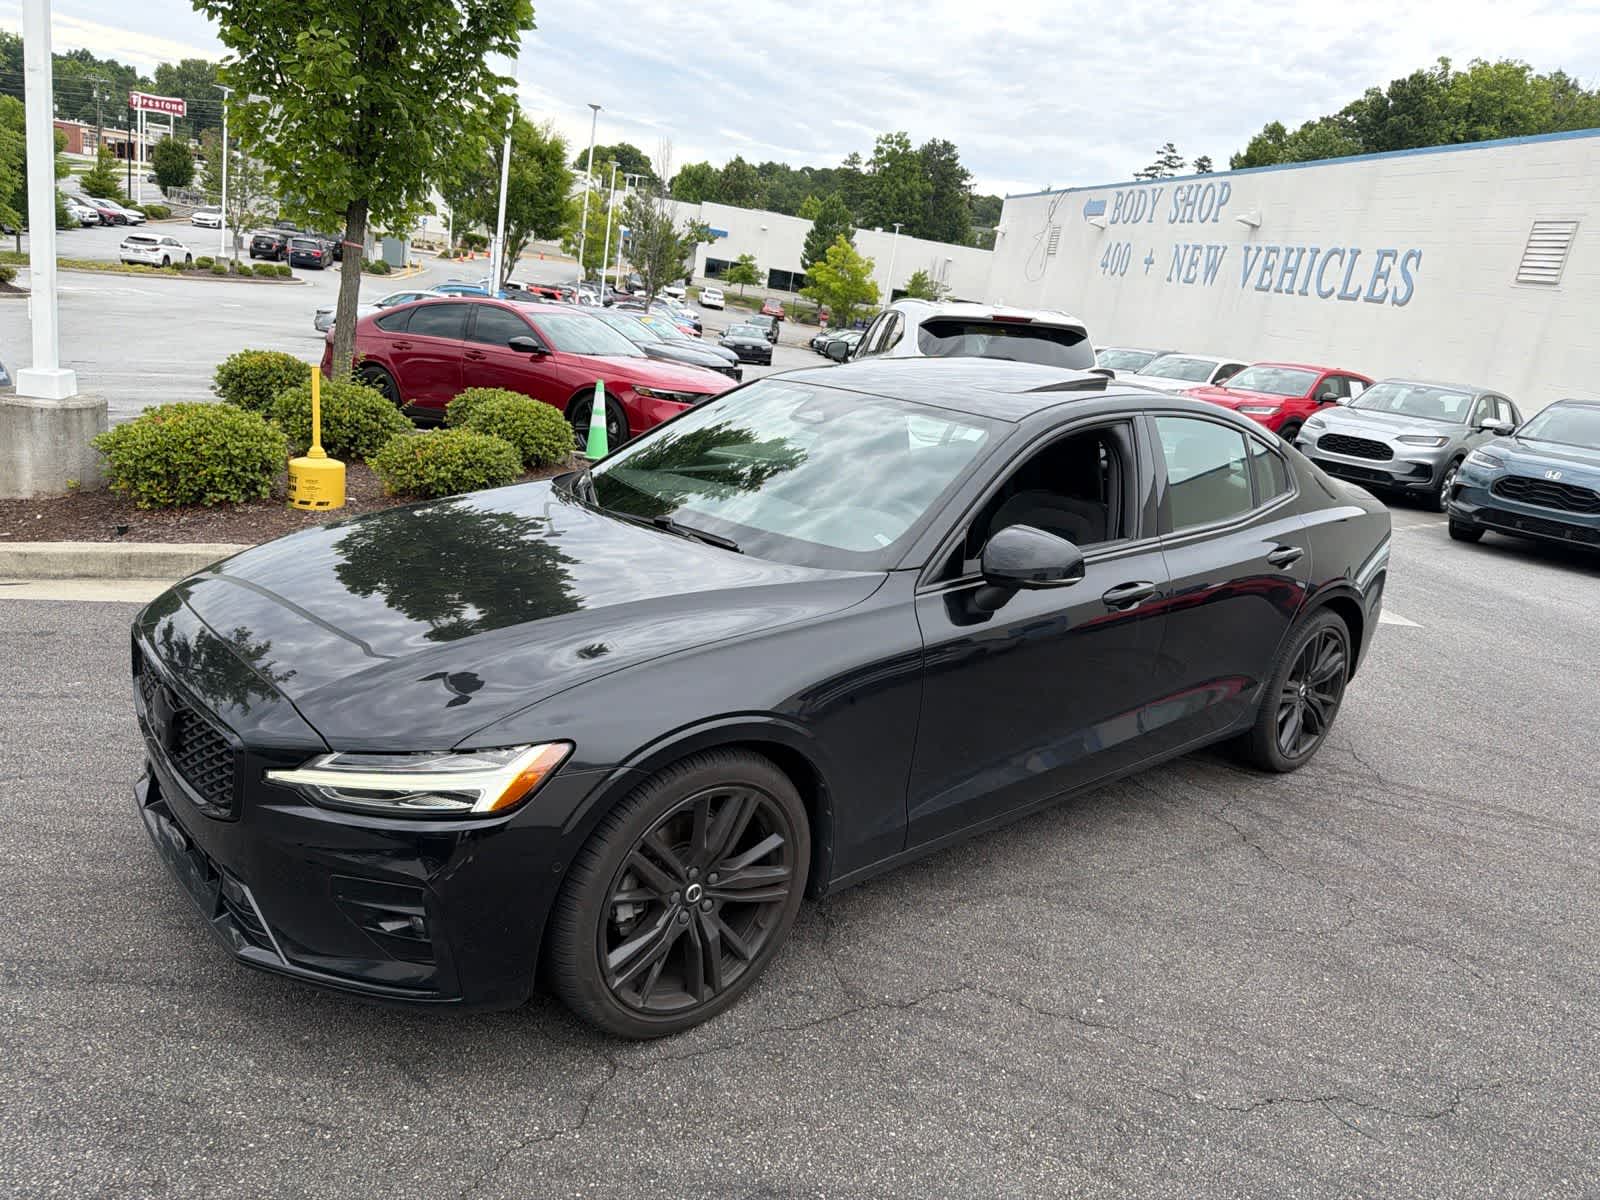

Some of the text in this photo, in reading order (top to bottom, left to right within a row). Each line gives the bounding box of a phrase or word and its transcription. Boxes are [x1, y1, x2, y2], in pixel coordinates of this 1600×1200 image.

[131, 95, 184, 112] Frestone
[1110, 181, 1232, 225] BODY SHOP
[1100, 243, 1423, 307] 400 + NEW VEHICLES
